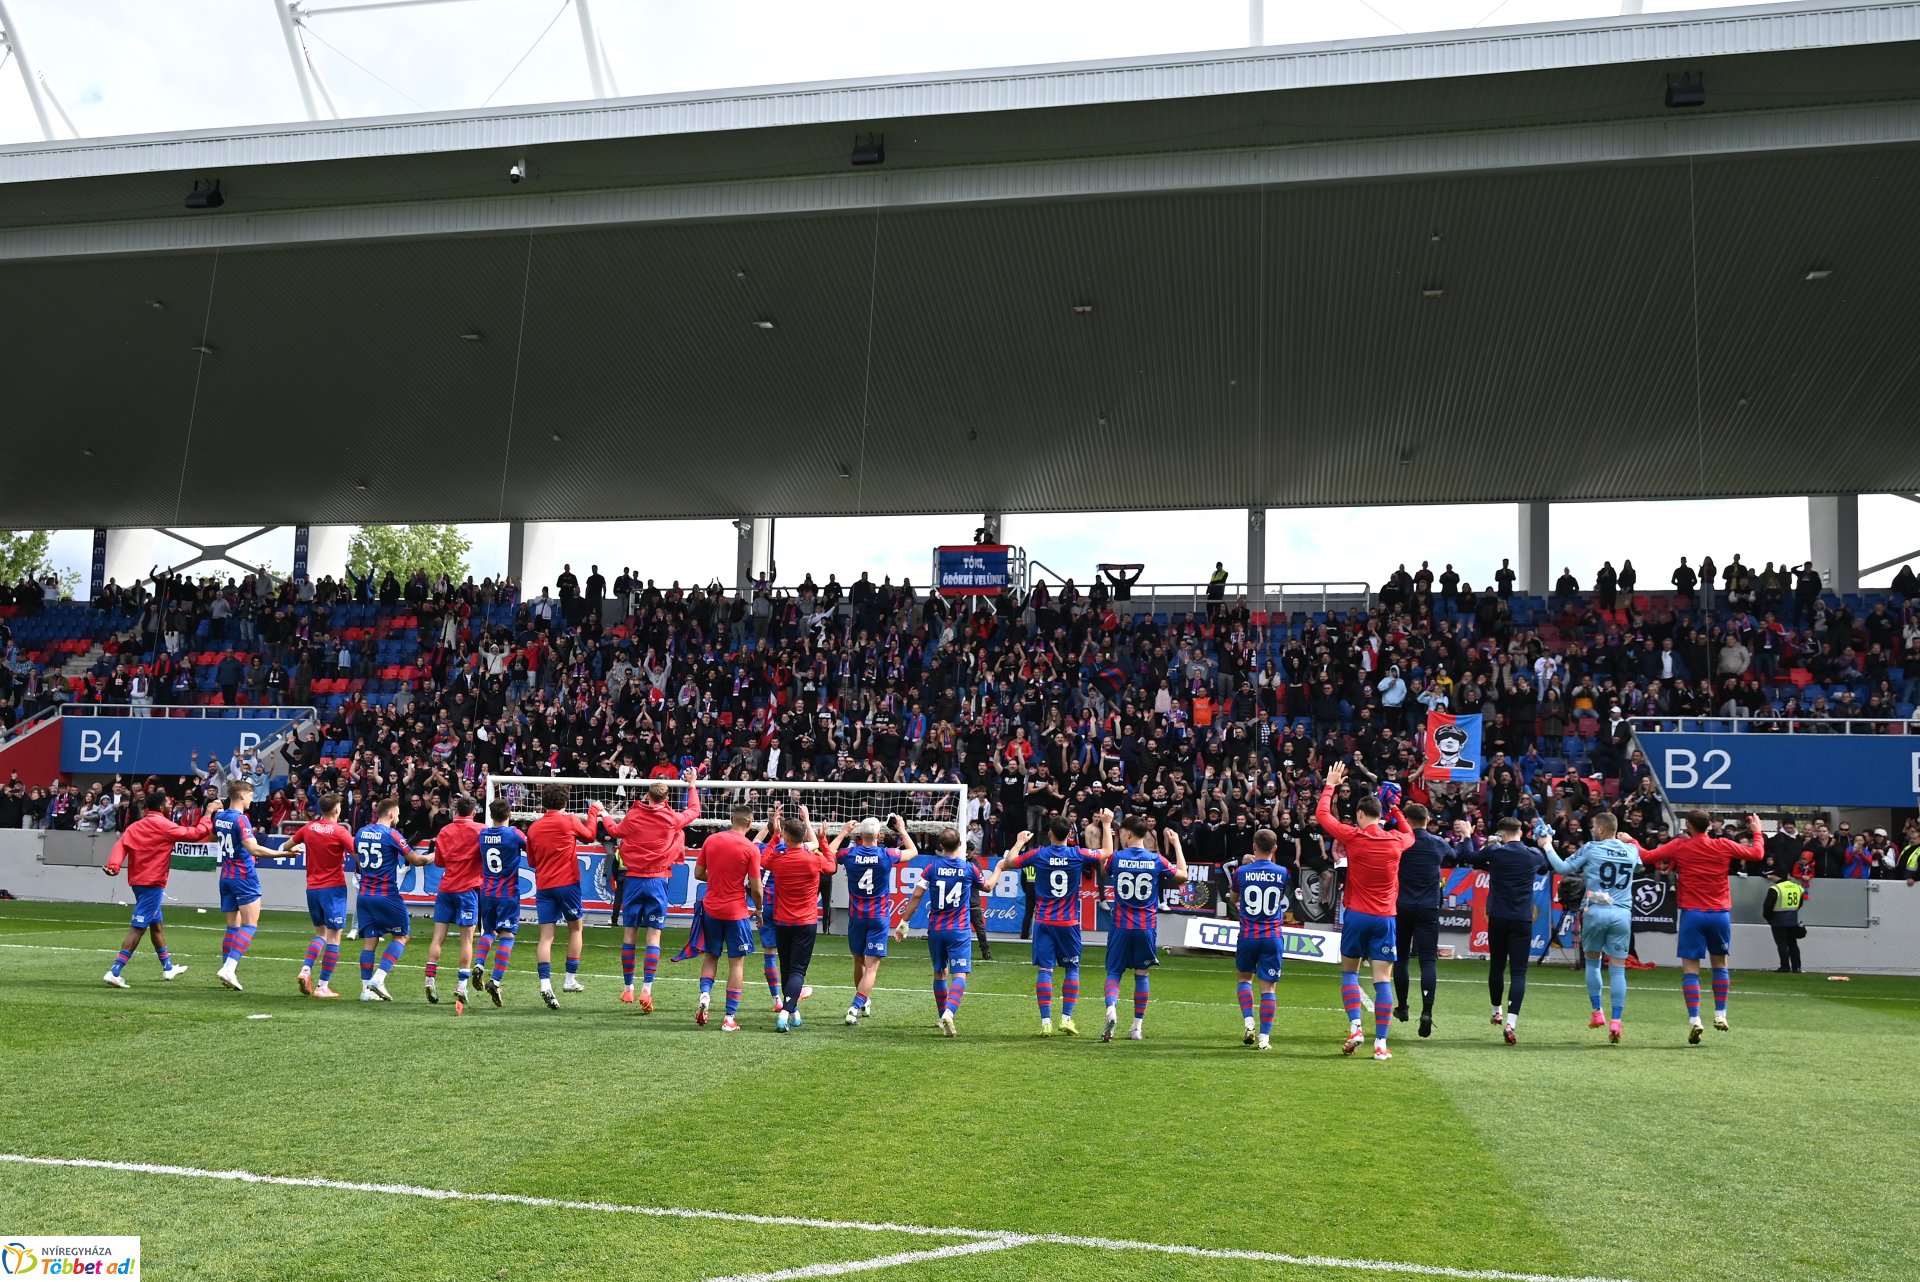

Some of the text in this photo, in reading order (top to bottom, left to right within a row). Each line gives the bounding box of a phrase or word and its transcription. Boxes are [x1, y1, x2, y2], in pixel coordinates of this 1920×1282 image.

[80, 729, 123, 763] B4
[1665, 748, 1732, 790] B2
[171, 843, 209, 856] ARGITTA
[217, 831, 235, 859] 24
[358, 842, 383, 869] 55
[486, 847, 503, 873] 6
[938, 868, 956, 876] NAGY
[858, 868, 874, 894] 4
[1050, 870, 1068, 897] 9
[1117, 872, 1153, 900] 66
[1245, 870, 1275, 882] KOVÁCS
[1599, 861, 1632, 889] 95
[936, 880, 963, 909] 14
[1244, 885, 1281, 916] 90
[1787, 892, 1799, 905] 58
